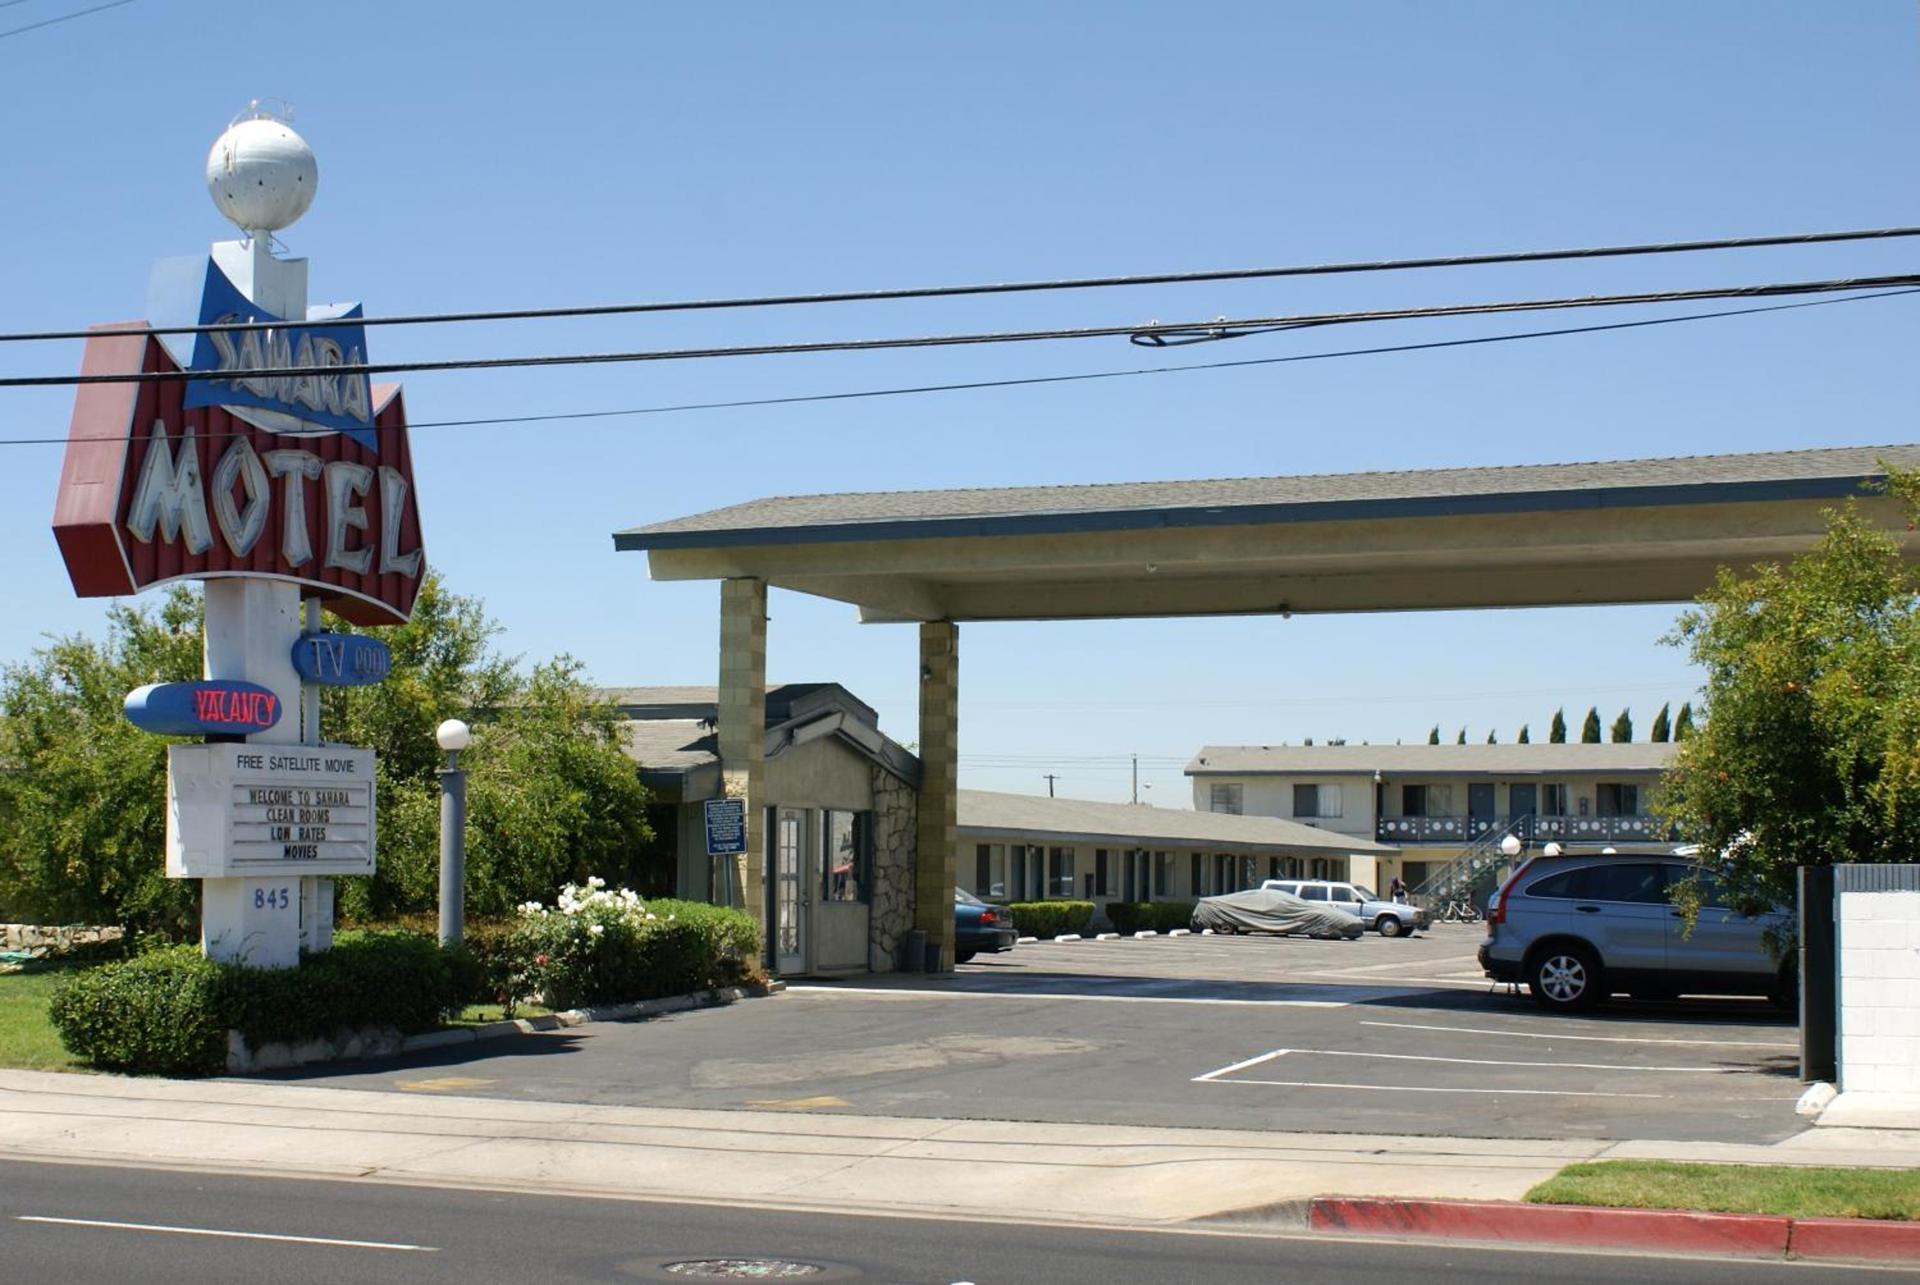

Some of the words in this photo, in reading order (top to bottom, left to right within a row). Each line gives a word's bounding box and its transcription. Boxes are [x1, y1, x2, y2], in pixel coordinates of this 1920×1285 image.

[209, 313, 369, 424] SAHARA
[126, 418, 423, 579] MOTEL
[308, 638, 345, 677] TV
[194, 690, 277, 726] VACANCY
[237, 754, 264, 770] FREE
[269, 756, 321, 773] SATELLITE
[325, 759, 354, 773] MOVIE
[249, 788, 293, 805] WELCOME
[298, 790, 311, 804] TO
[316, 791, 350, 806] SAHARA
[266, 808, 295, 823] CLEAN
[300, 809, 331, 824] ROOMS
[270, 826, 292, 841] LOW
[298, 827, 327, 841] RATES
[283, 844, 318, 859] MOVIES
[254, 888, 289, 910] 845
